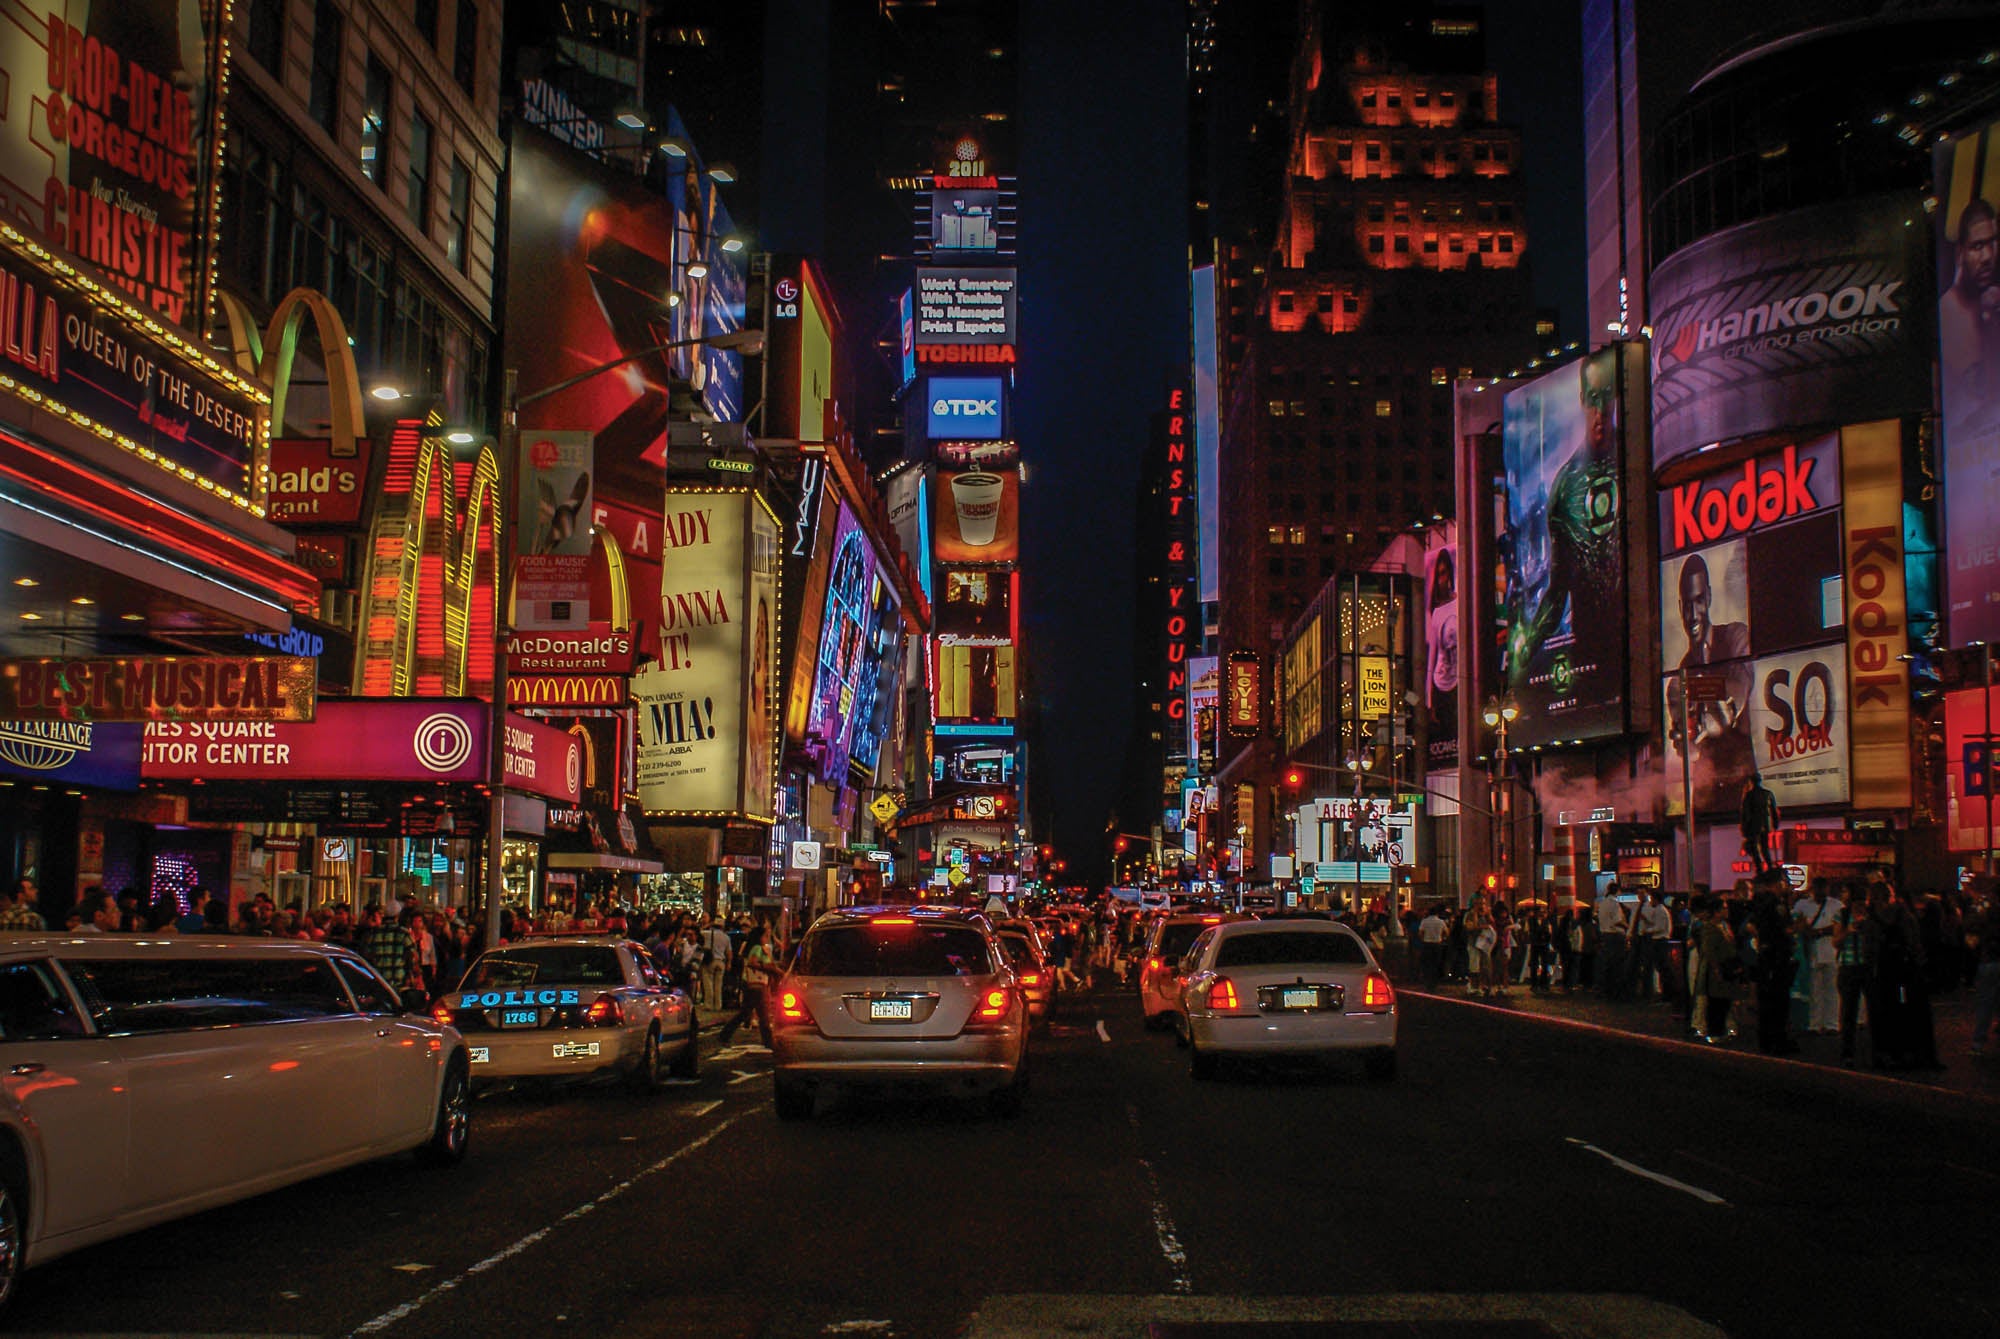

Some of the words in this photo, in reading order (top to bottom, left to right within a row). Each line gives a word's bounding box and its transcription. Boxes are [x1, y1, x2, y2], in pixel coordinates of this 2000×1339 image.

[47, 11, 191, 155] DROP-DEAD
[46, 92, 190, 200] GORGEOUS
[949, 159, 985, 177] 2011
[933, 174, 998, 189] TOSHIBA
[44, 176, 185, 295] CHRISTIE
[921, 278, 956, 291] Work
[959, 278, 1013, 291] Smarter
[921, 292, 952, 304] With
[955, 292, 1003, 304] Toshiba
[776, 304, 796, 317] LG
[920, 306, 944, 318] The
[947, 307, 1004, 320] Managed
[921, 321, 953, 333] Print
[956, 321, 1006, 335] Experts
[1723, 332, 1794, 359] driving
[1796, 316, 1900, 346] emotion
[915, 344, 1016, 362] TOSHIBA
[65, 314, 127, 374] QUEEN
[132, 354, 154, 387] OF
[159, 369, 190, 411] THE
[195, 393, 253, 447] DESERT
[948, 399, 998, 416] TDK
[1167, 389, 1184, 517] ERNST
[712, 460, 750, 472] LAMAR
[1672, 446, 1818, 549] Kodak
[1167, 541, 1184, 561] &
[555, 557, 588, 568] MUSIC
[659, 588, 730, 631] ONNA
[1850, 525, 1902, 709] Kodak
[507, 636, 629, 655] McDonald's
[1167, 586, 1185, 719] YOUNG
[521, 656, 607, 669] Restaurant
[1366, 669, 1383, 678] THE
[18, 661, 111, 708] BEST
[123, 663, 287, 709] MUSICAL
[1362, 680, 1386, 695] LION
[1363, 697, 1388, 711] KING
[1763, 660, 1837, 745] SO
[650, 697, 716, 746] MIA!
[511, 728, 534, 753] SQUARE
[1769, 719, 1834, 762] Kodak
[206, 743, 291, 764] CENTER
[669, 747, 693, 756] ABBA
[514, 755, 536, 779] CENTER
[460, 989, 580, 1009] POLICE
[504, 1011, 536, 1024] 1786
